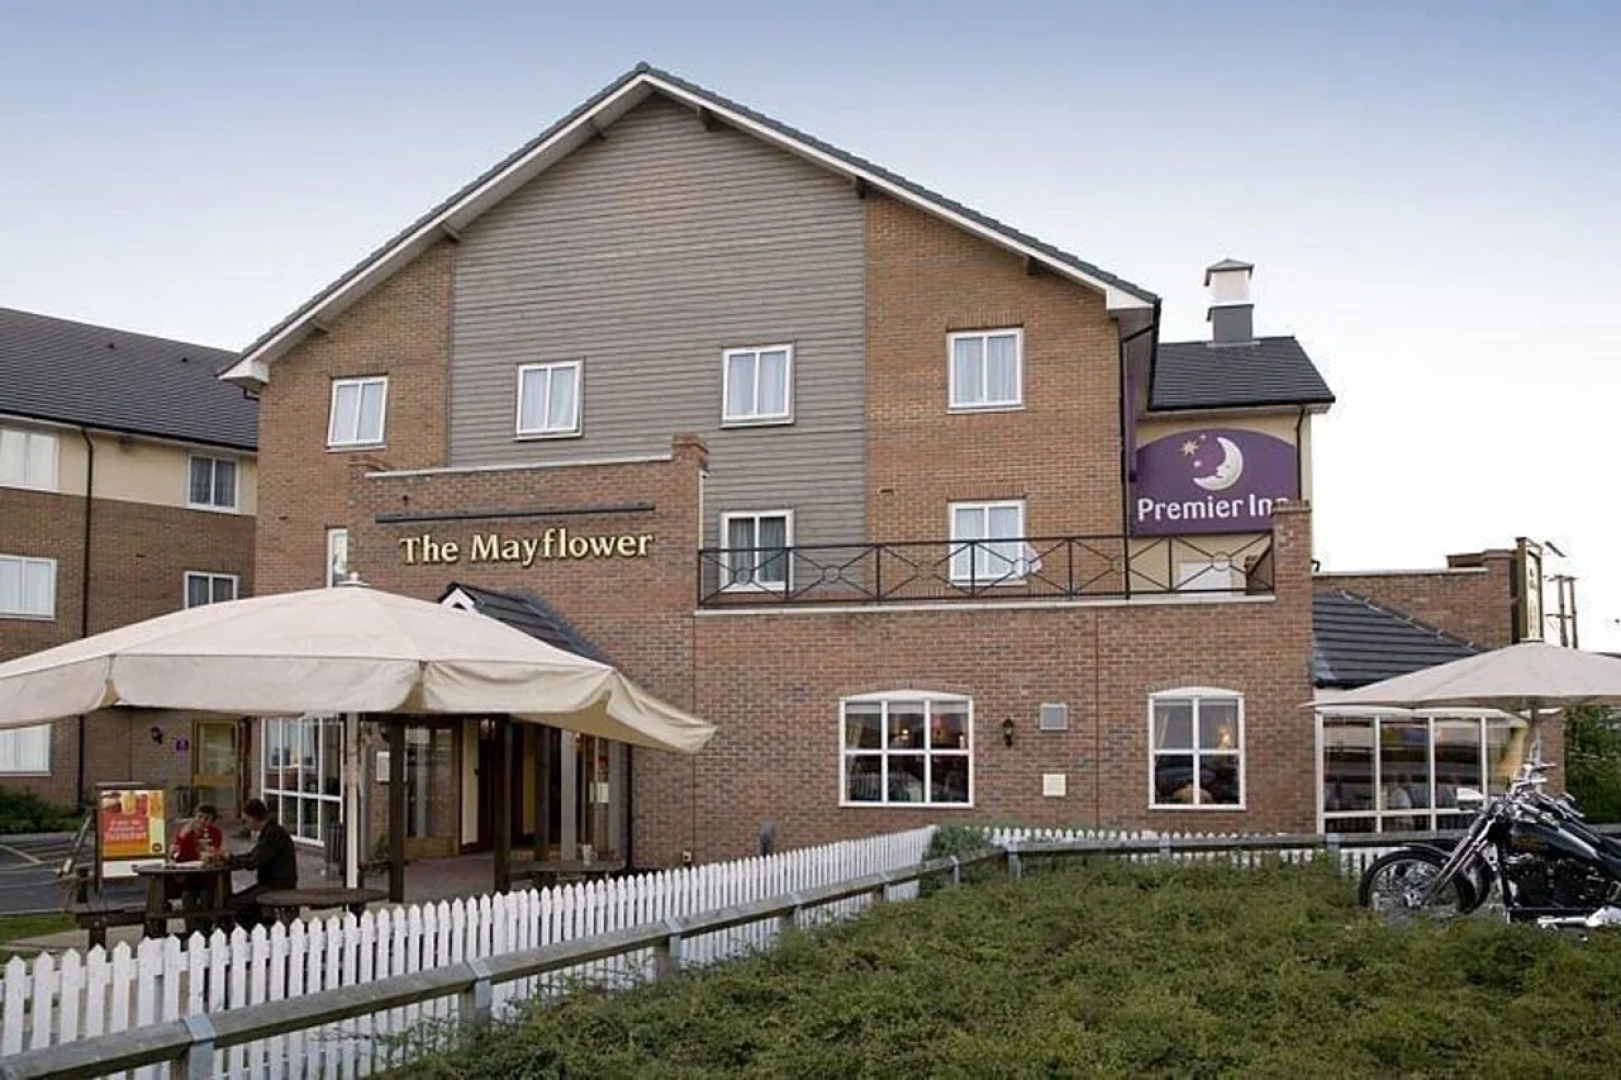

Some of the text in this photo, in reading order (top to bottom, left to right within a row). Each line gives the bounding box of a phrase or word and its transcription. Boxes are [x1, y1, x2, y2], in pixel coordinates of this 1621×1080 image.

[1138, 494, 1289, 522] Premier In
[399, 528, 653, 568] The Mayflower
